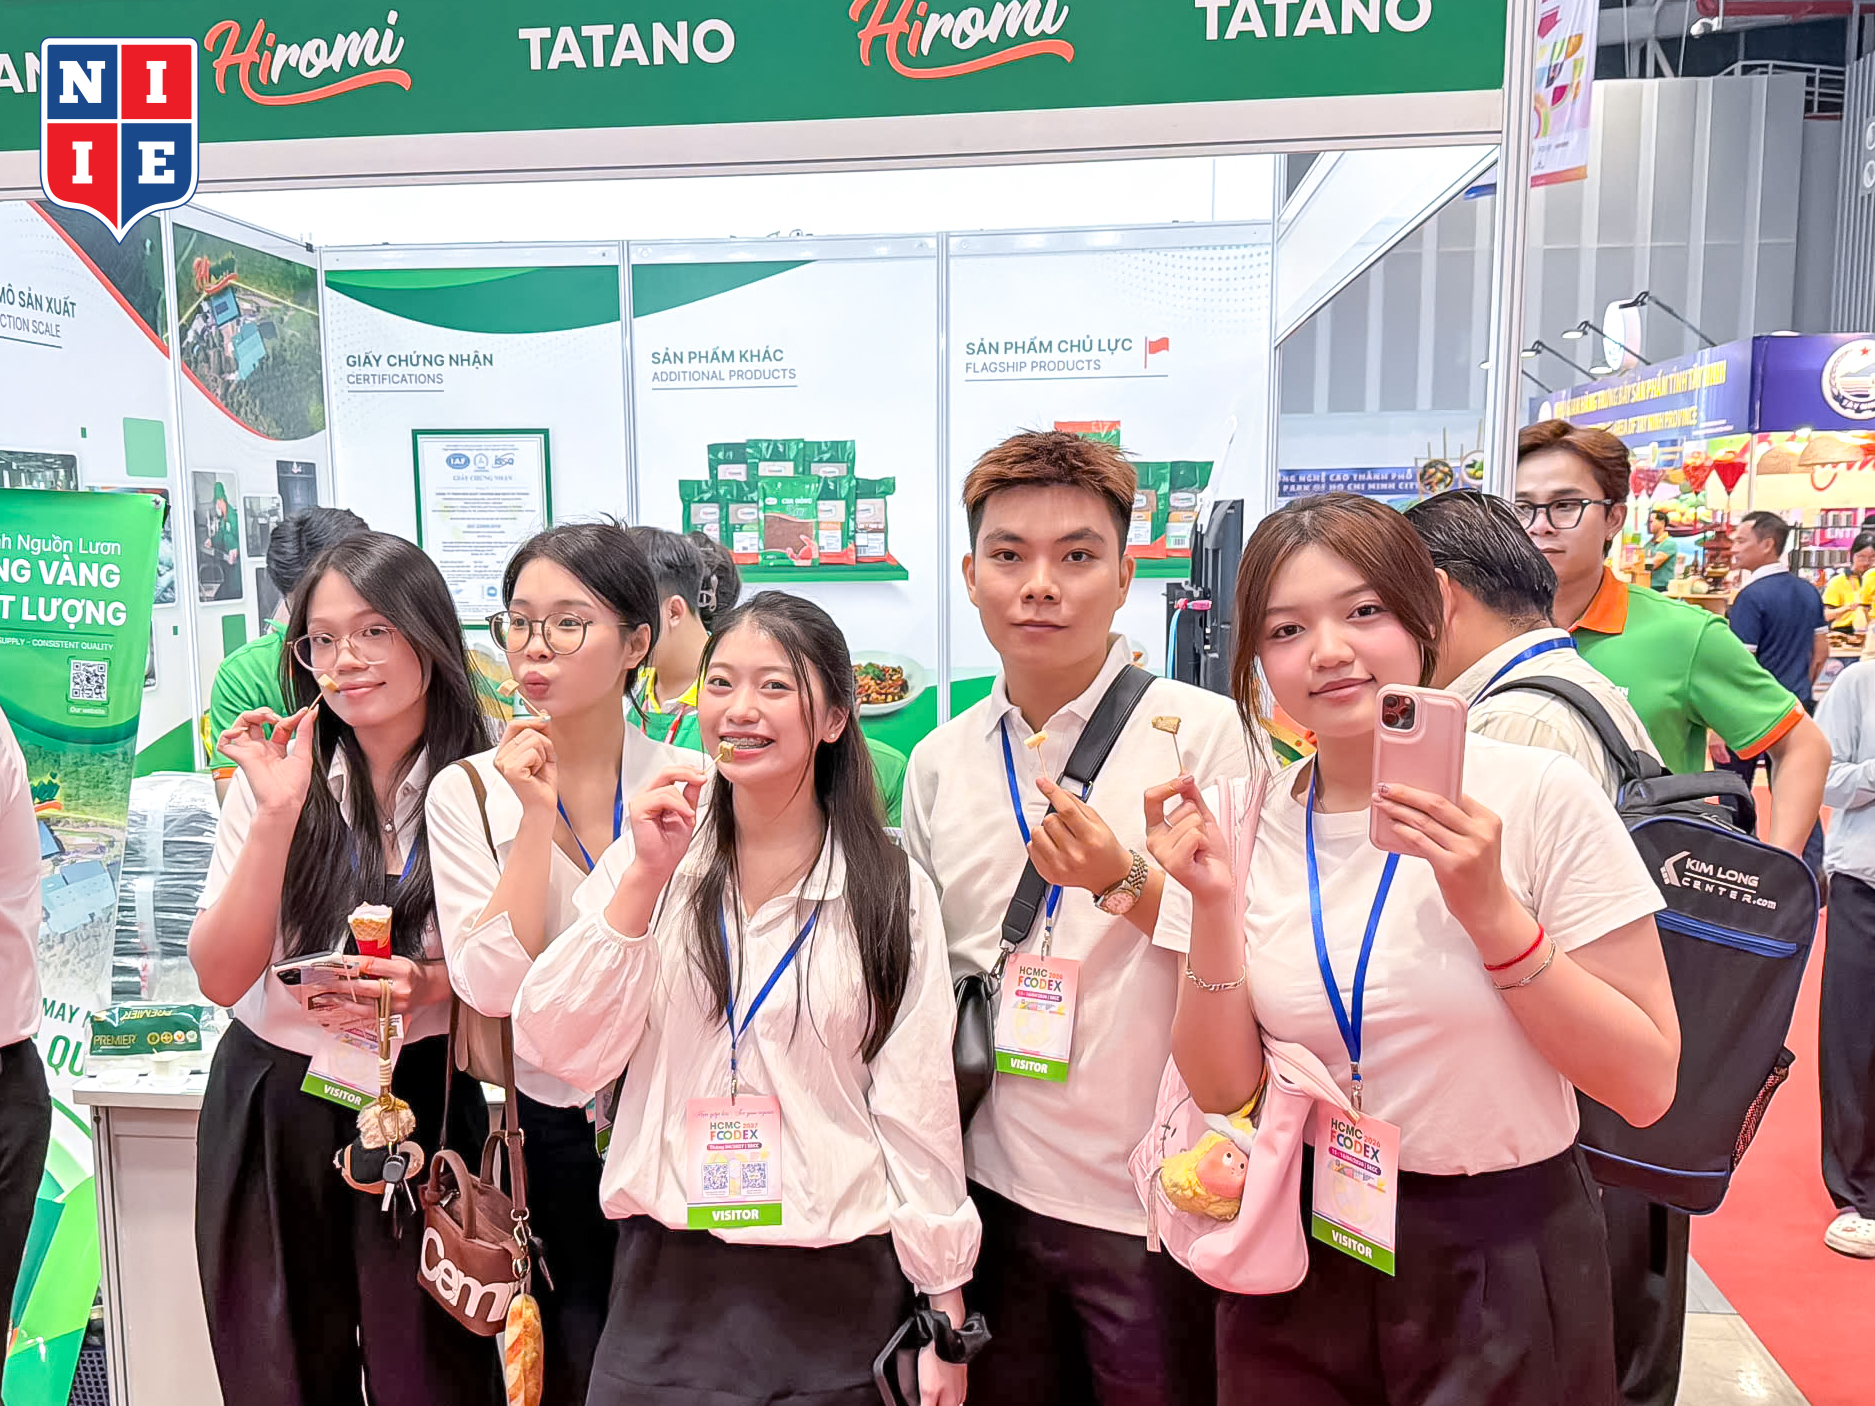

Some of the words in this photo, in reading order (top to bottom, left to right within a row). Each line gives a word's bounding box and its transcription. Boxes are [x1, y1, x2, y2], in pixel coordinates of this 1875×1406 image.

[204, 10, 411, 106] Hiromi
[518, 18, 736, 71] TATANO
[848, 0, 1075, 79] Hiromi
[1194, 0, 1433, 41] TATANO
[18, 286, 43, 311] SẢN
[45, 295, 77, 318] XUẤT
[31, 319, 61, 338] SCALE
[965, 338, 1000, 355] SẢN
[1003, 336, 1053, 355] PHẨM
[1057, 334, 1093, 353] CHỦ
[1097, 337, 1133, 355] LỰC
[346, 350, 382, 368] GIẤY
[386, 350, 445, 367] CHỨNG
[449, 350, 494, 370] NHẬN
[651, 347, 684, 365] SẢN
[687, 345, 735, 364] PHẨM
[739, 345, 784, 363] KHÁC
[651, 370, 725, 382] ADDITIONAL
[728, 368, 797, 381] PRODUCTS
[965, 361, 1027, 374] FLAGSHIP
[1030, 359, 1101, 373] PRODUCTS
[346, 373, 444, 385] CERTIFICATIONS
[1329, 473, 1350, 481] CAO
[1367, 482, 1395, 490] MINH
[17, 534, 73, 556] Nguồn
[78, 537, 121, 556] Lươn
[38, 554, 121, 589] VÀNG
[21, 597, 127, 630] LƯỢNG
[32, 638, 80, 649] CONSISTENT
[81, 641, 114, 651] QUALITY
[1685, 857, 1713, 876] KIM
[1717, 866, 1759, 888] LONG
[1020, 965, 1048, 978] HCMC
[1018, 975, 1062, 992] FCODEX
[93, 1033, 137, 1046] PREMIER
[1010, 1057, 1048, 1074] VISITOR
[323, 1084, 362, 1106] VISITOR
[709, 1121, 741, 1131] HCMC
[710, 1129, 759, 1142] FCODEX
[1331, 1117, 1363, 1140] HCMC
[1330, 1128, 1380, 1164] FCODEX
[711, 1209, 760, 1222] VISITOR
[1331, 1229, 1373, 1260] VISITOR
